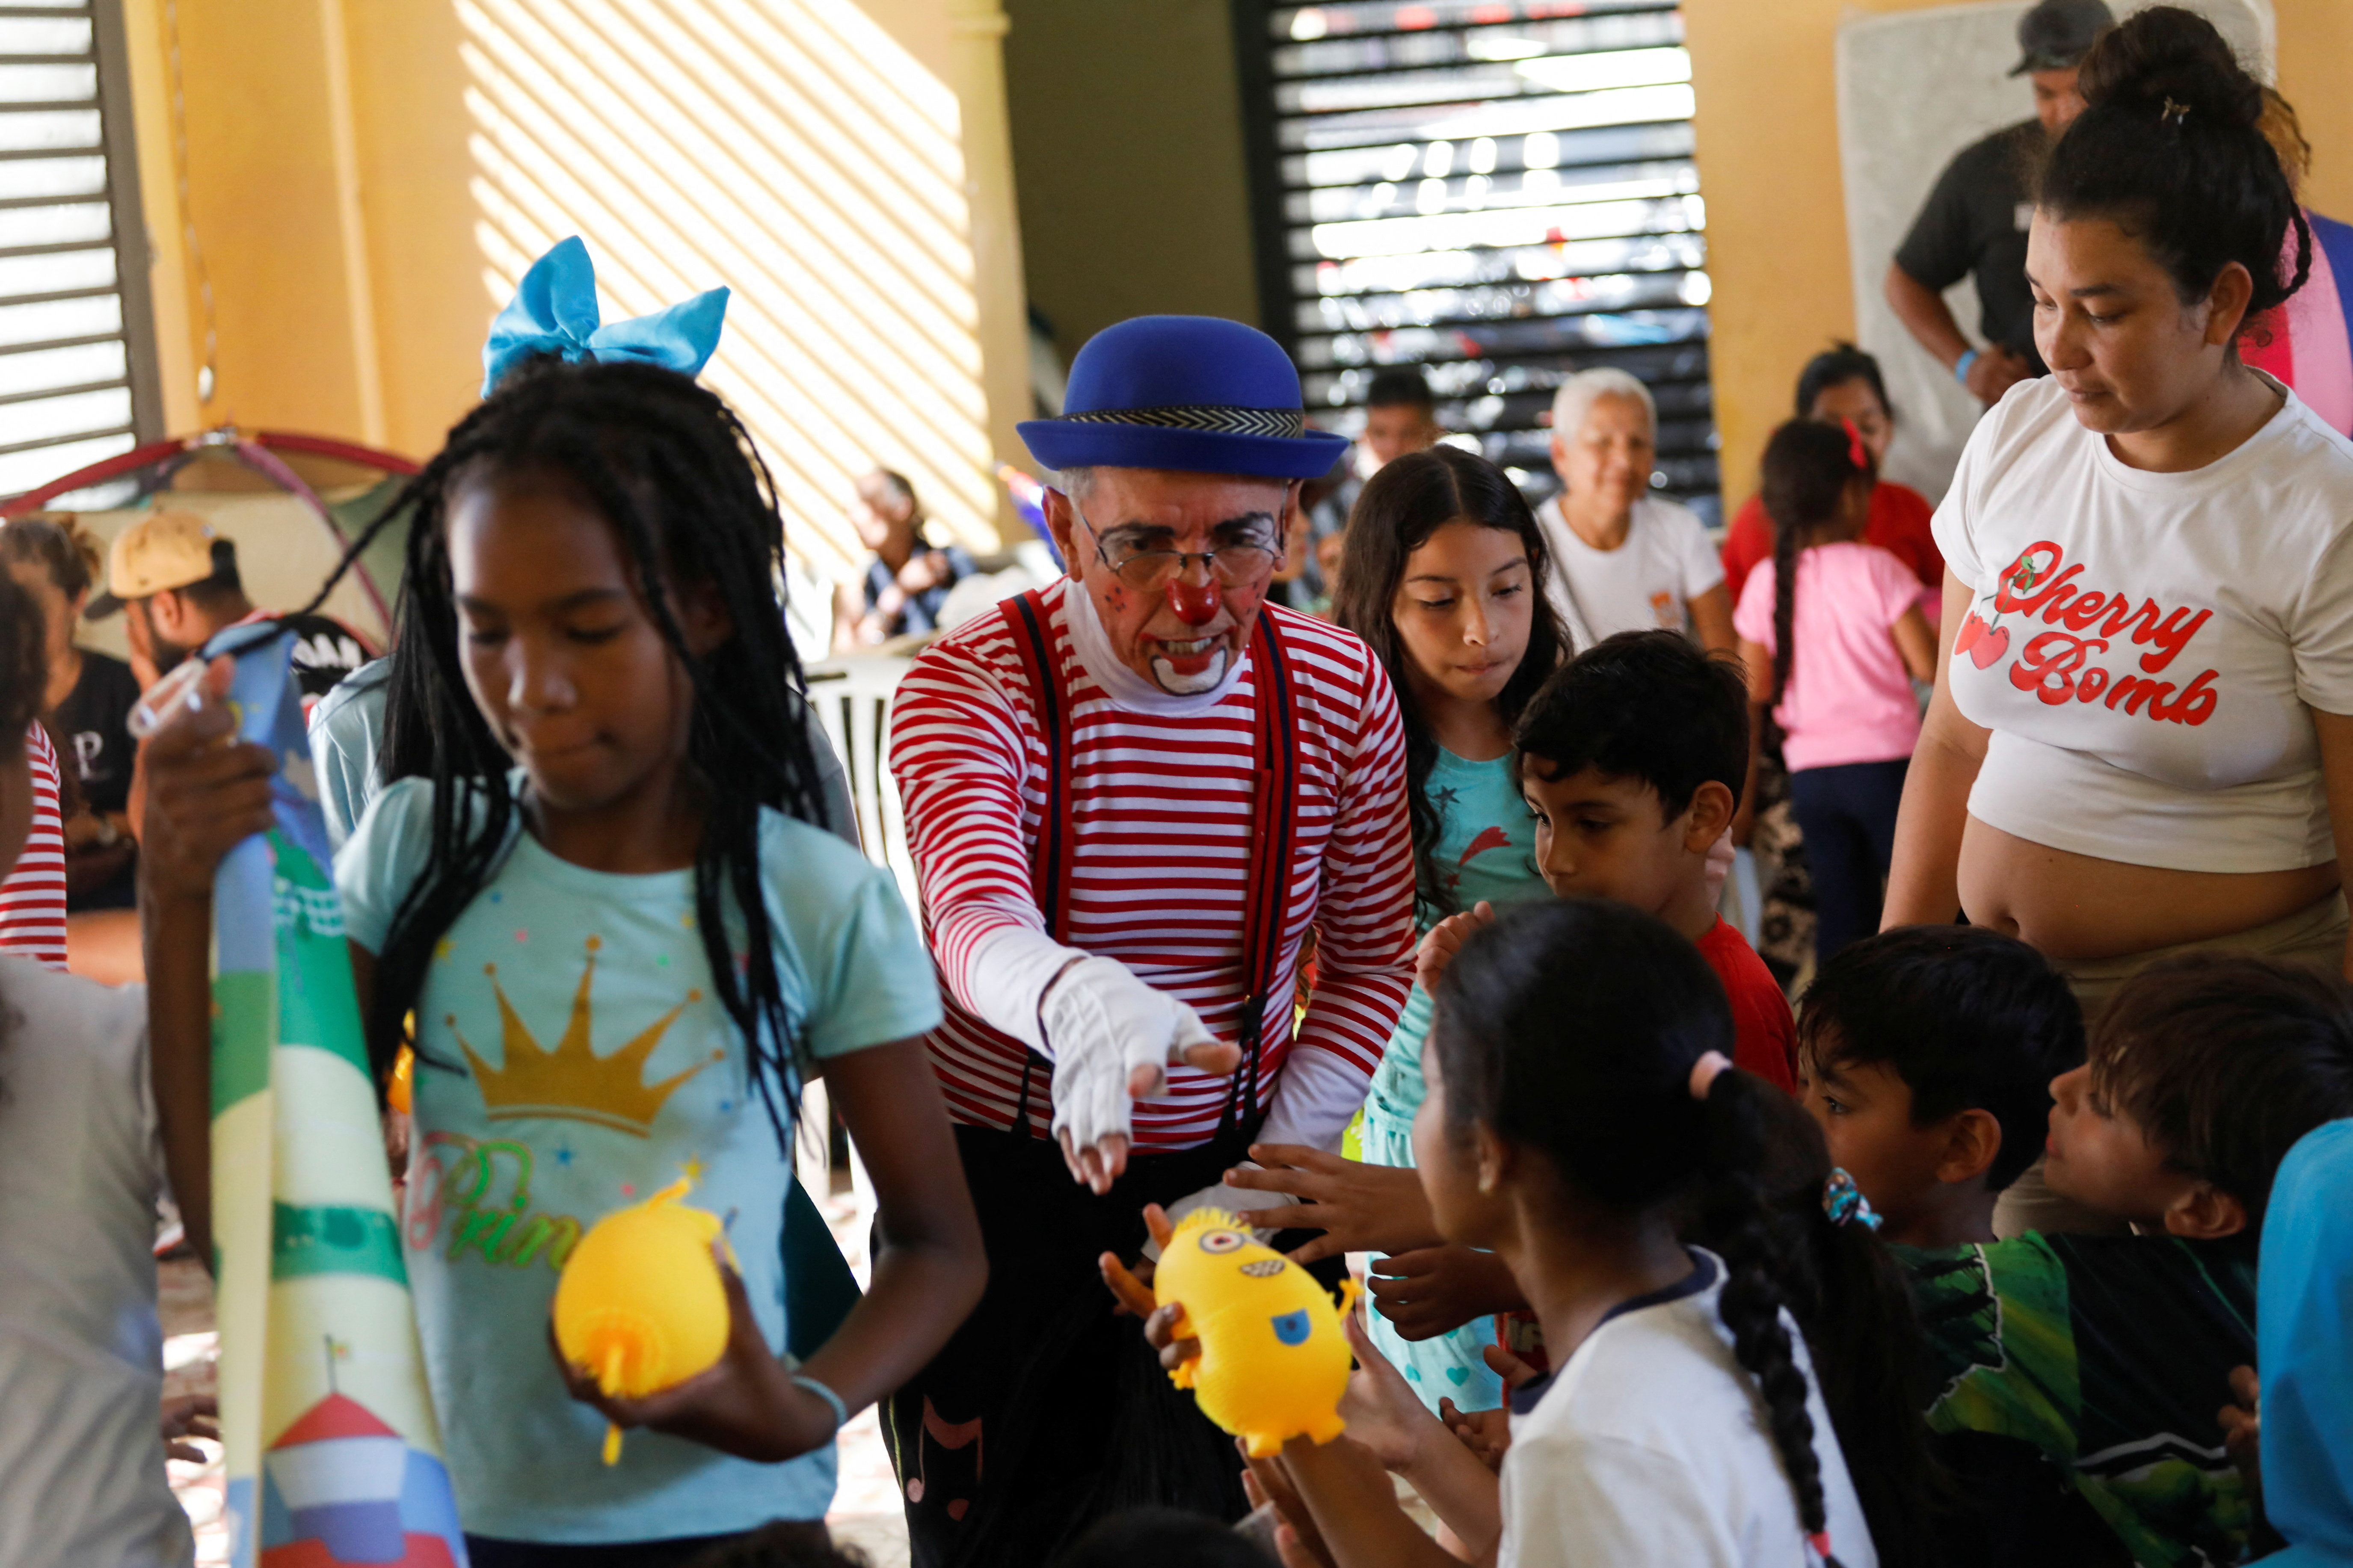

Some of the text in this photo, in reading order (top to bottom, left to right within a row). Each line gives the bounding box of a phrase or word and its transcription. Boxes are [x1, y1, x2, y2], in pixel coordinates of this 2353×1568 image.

[1995, 541, 2213, 674] Cherry
[2009, 631, 2219, 726] Bomb
[408, 1130, 583, 1270] Prin
